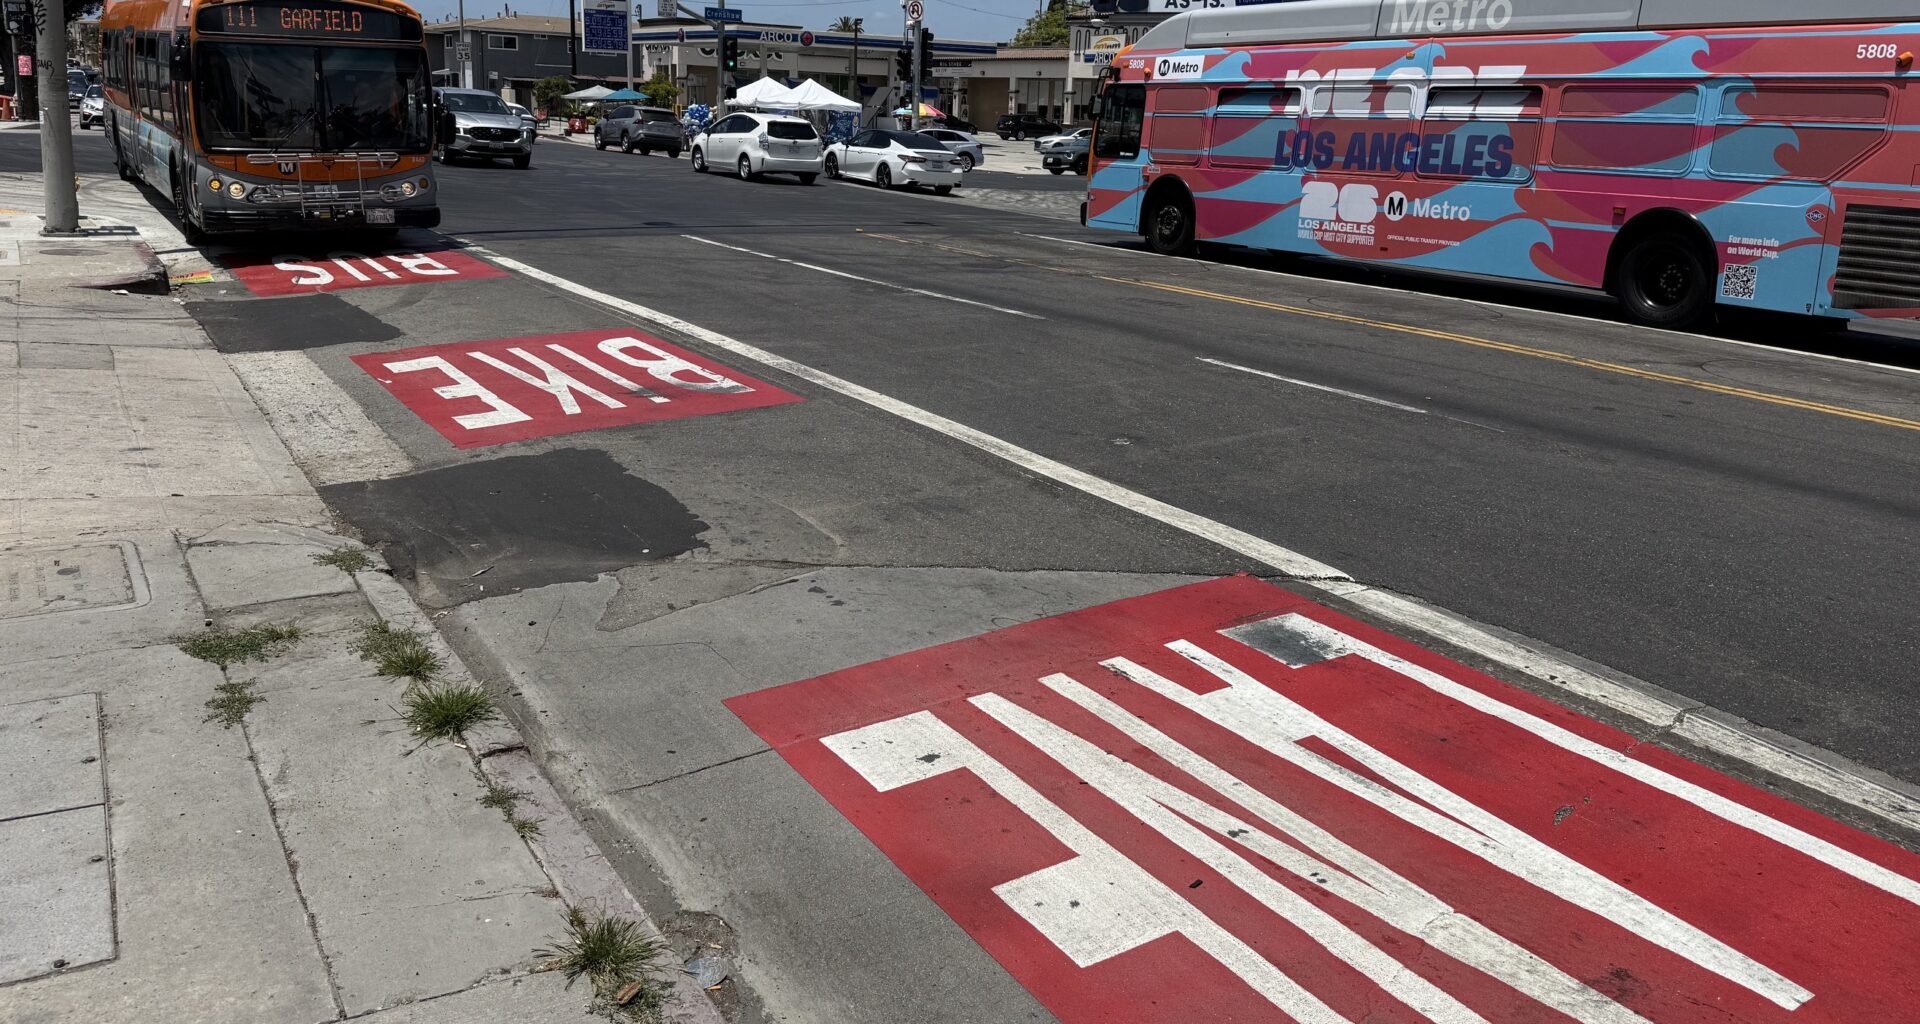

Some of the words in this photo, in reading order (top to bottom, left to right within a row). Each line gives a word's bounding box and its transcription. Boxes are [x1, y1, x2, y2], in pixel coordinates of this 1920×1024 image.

[227, 5, 257, 27] 111
[281, 8, 362, 32] GARFIELD
[706, 10, 740, 19] Crenshaw
[1390, 0, 1513, 33] Metro
[760, 31, 792, 42] ARCO
[1856, 44, 1897, 59] 5808
[1129, 60, 1144, 69] 5808
[1172, 62, 1198, 73] Metro
[1274, 130, 1336, 169] LOS
[1342, 132, 1514, 177] ANGELES
[1299, 181, 1378, 223] 26
[1413, 198, 1470, 221] Metro
[1298, 219, 1319, 229] LOS
[1322, 221, 1375, 234] ANGELES
[1314, 231, 1323, 240] CUP
[1336, 233, 1346, 243] CITY
[1347, 234, 1374, 246] SUPPORTER
[1729, 235, 1741, 243] For
[1741, 237, 1762, 246] more
[1763, 238, 1779, 247] info
[1738, 247, 1761, 257] World
[1762, 249, 1779, 259] Cup.
[383, 336, 756, 430] BIKE
